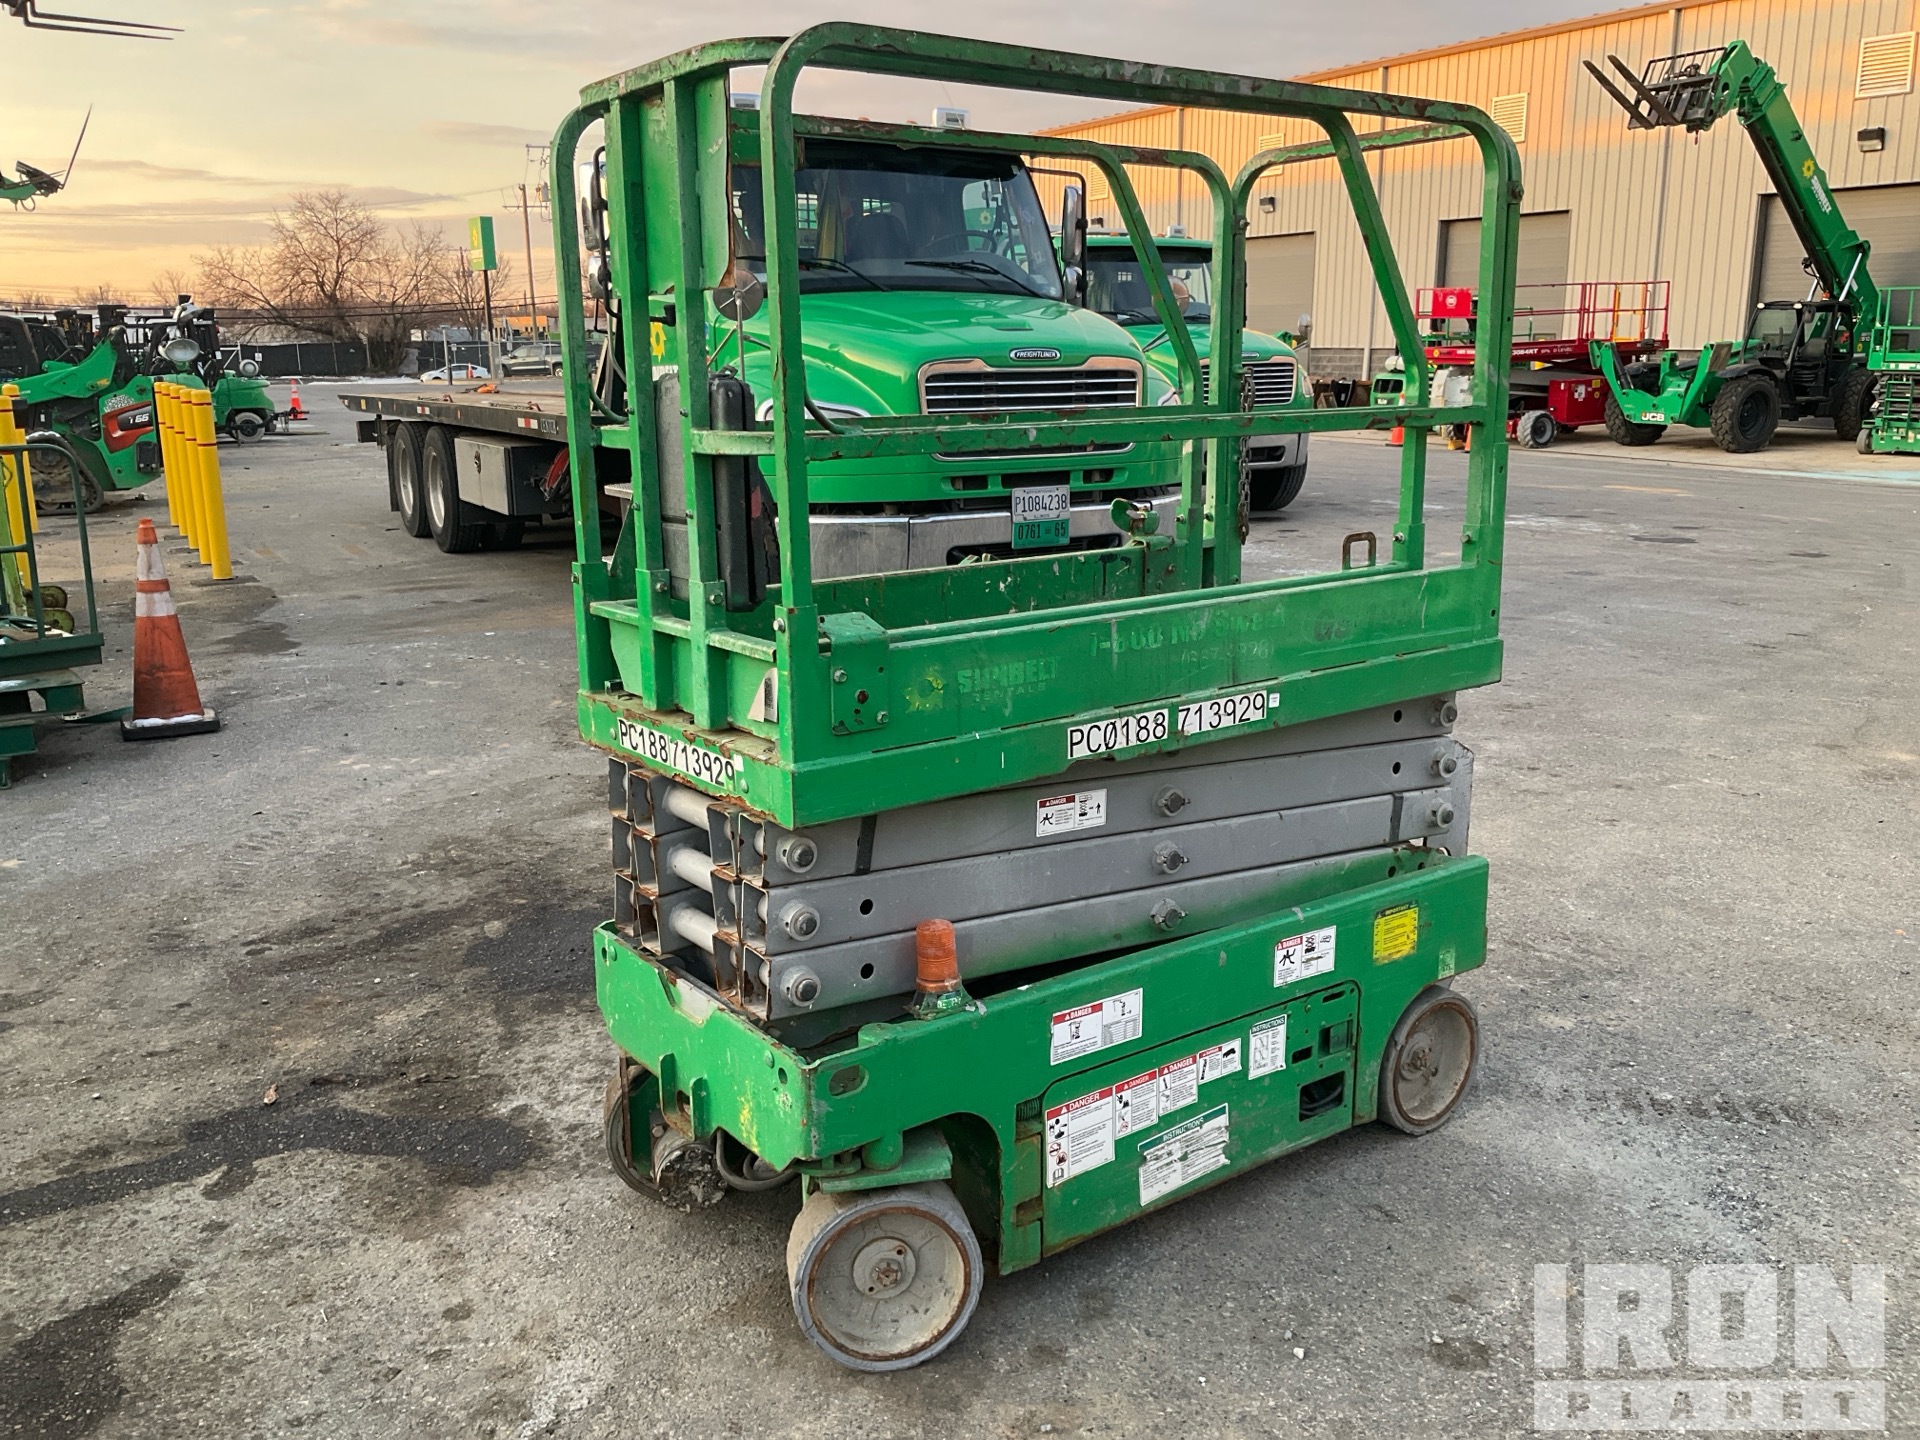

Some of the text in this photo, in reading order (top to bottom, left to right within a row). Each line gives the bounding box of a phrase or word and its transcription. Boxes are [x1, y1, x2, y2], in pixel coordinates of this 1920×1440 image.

[1016, 350, 1056, 358] FREIGHTLINER
[1641, 411, 1665, 422] JCB
[1015, 493, 1068, 513] P1084238
[1018, 521, 1066, 541] 0761 65
[1179, 692, 1266, 732] 713929
[1070, 1007, 1092, 1019] DANGER
[1169, 1057, 1194, 1072] DANGER
[1128, 1075, 1150, 1085] DANGER
[1069, 1093, 1100, 1110] DANGER
